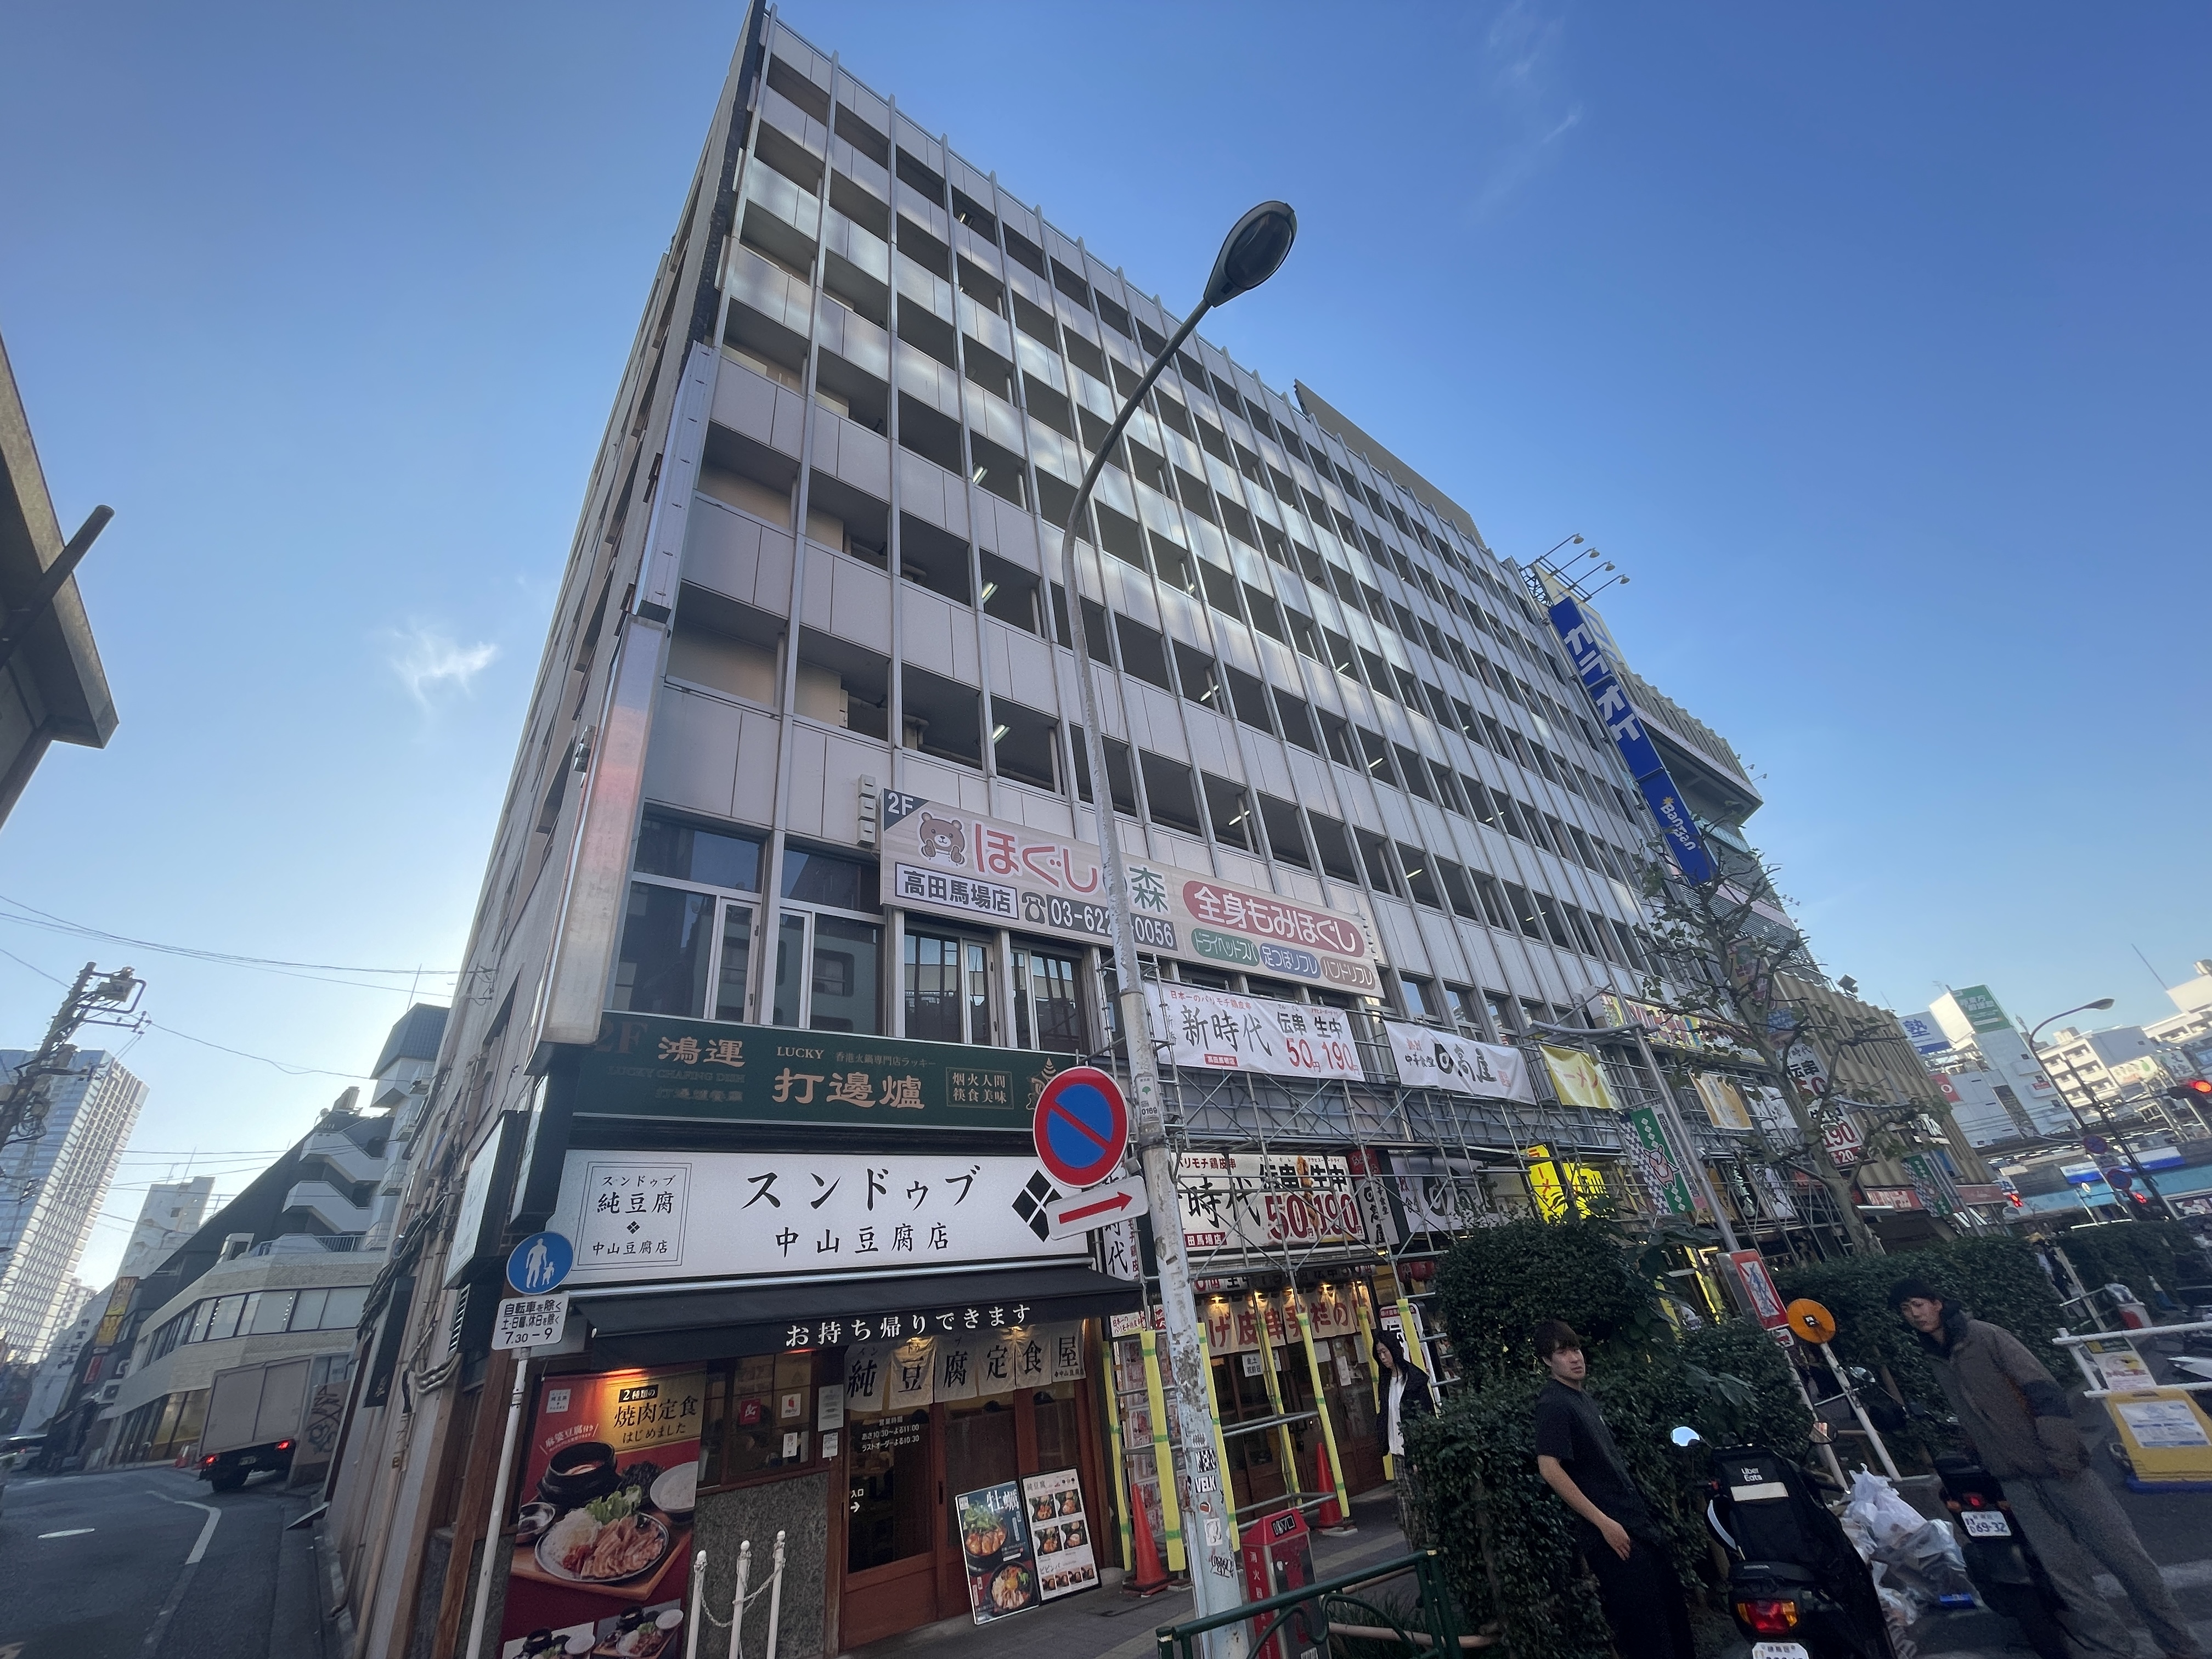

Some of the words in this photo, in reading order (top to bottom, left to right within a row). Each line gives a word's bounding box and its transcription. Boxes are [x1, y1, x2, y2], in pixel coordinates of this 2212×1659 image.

[1564, 623, 1641, 742] カラオケ
[887, 792, 915, 816] 2F
[975, 823, 1169, 915] ほぐし森
[903, 870, 1012, 915] 高田馬場店
[1050, 898, 1173, 948] 03-622-0056
[1193, 885, 1356, 953] 全身もみほぐし
[1194, 934, 1258, 963] ドライヘッドスパ
[1261, 946, 1318, 974] 足つぼリフレ
[1323, 959, 1373, 986] ハンドリフレ
[1180, 1004, 1272, 1057] 新時代
[1277, 1012, 1307, 1036] 伝串
[1314, 1015, 1343, 1040] 生中
[657, 1036, 746, 1068] 鴻運
[777, 1046, 824, 1059] LUCKY
[1286, 1037, 1321, 1073] 50円
[1321, 1041, 1361, 1076] 190円
[772, 1067, 925, 1110] 打邊爐
[602, 1174, 677, 1187] スンドゥブ
[740, 1164, 980, 1211] スンドゥブ
[596, 1191, 674, 1214] 純豆腐
[1178, 1169, 1261, 1229] 時代
[592, 1239, 668, 1255] 中山豆腐店
[775, 1222, 950, 1258] 中山豆腐店
[1184, 1233, 1223, 1247] 田馬場店
[504, 1299, 562, 1315] 自転車を除く
[786, 1304, 1031, 1347] お持ち帰りできます
[846, 1335, 1079, 1398] 純豆腐定食屋
[613, 1394, 699, 1429] 焼肉定食
[622, 1422, 686, 1444] はじめました
[851, 1488, 864, 1498] 入口
[1743, 1474, 1763, 1482] Eats
